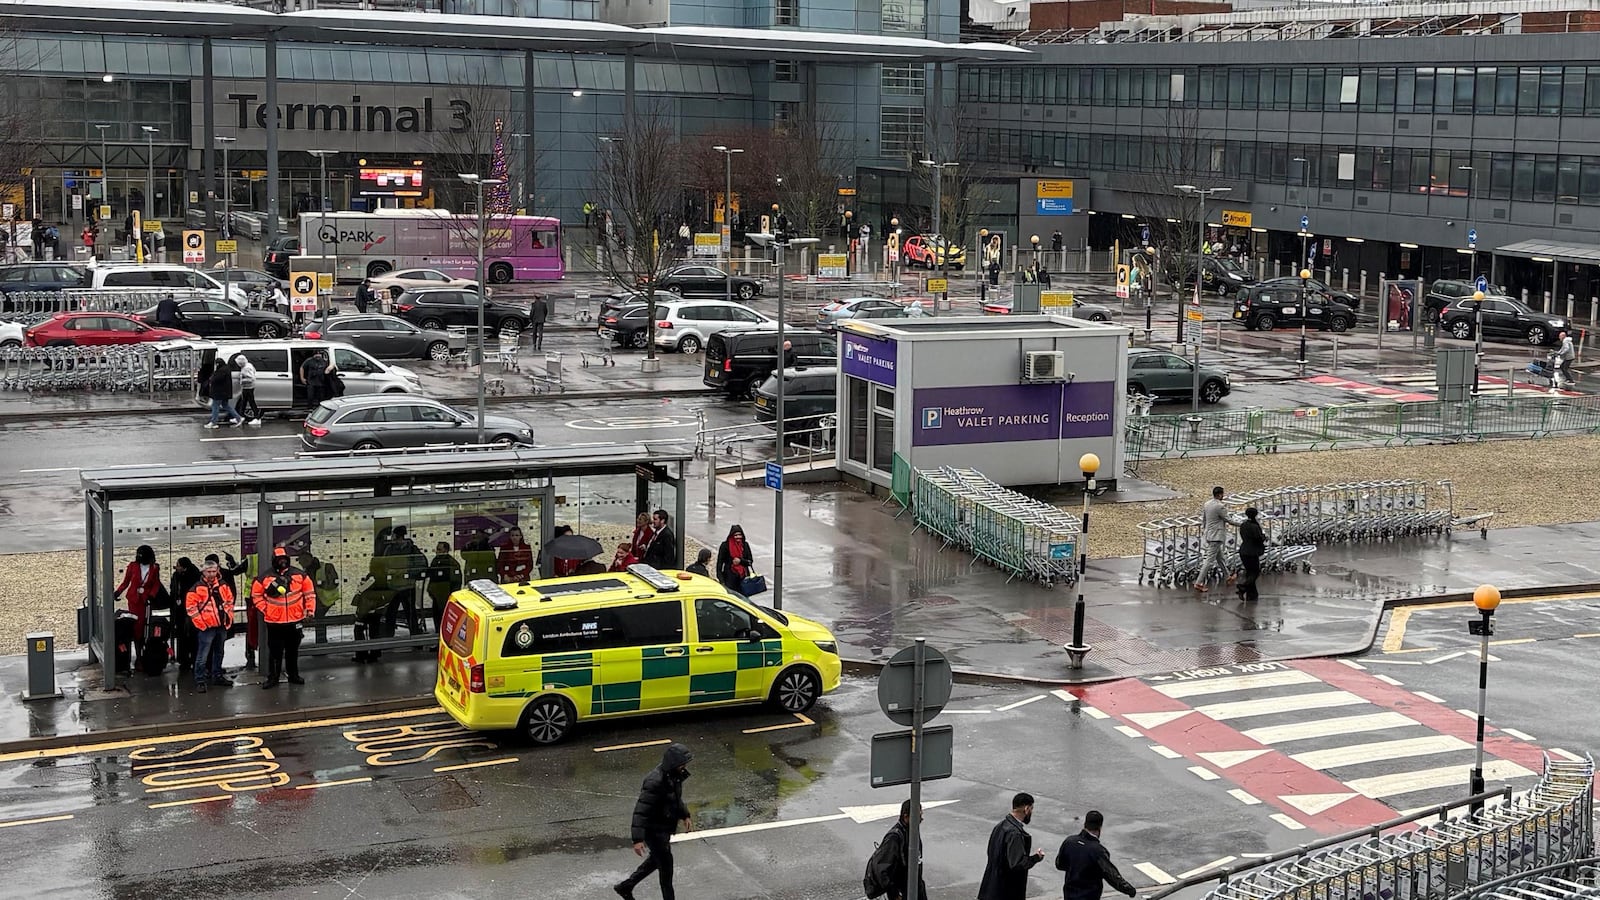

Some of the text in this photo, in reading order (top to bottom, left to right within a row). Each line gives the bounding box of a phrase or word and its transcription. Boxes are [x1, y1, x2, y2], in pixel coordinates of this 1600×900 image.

[228, 94, 472, 133] Terminal 3
[857, 353, 894, 370] VALET PARKING
[944, 406, 984, 416] Heathrow
[1066, 412, 1109, 423] Reception
[957, 413, 1049, 427] VALET PARKING
[582, 622, 598, 630] NHS
[1173, 661, 1288, 681] LOOK RIGHT
[343, 720, 498, 766] BUS
[128, 735, 291, 794] STOP
